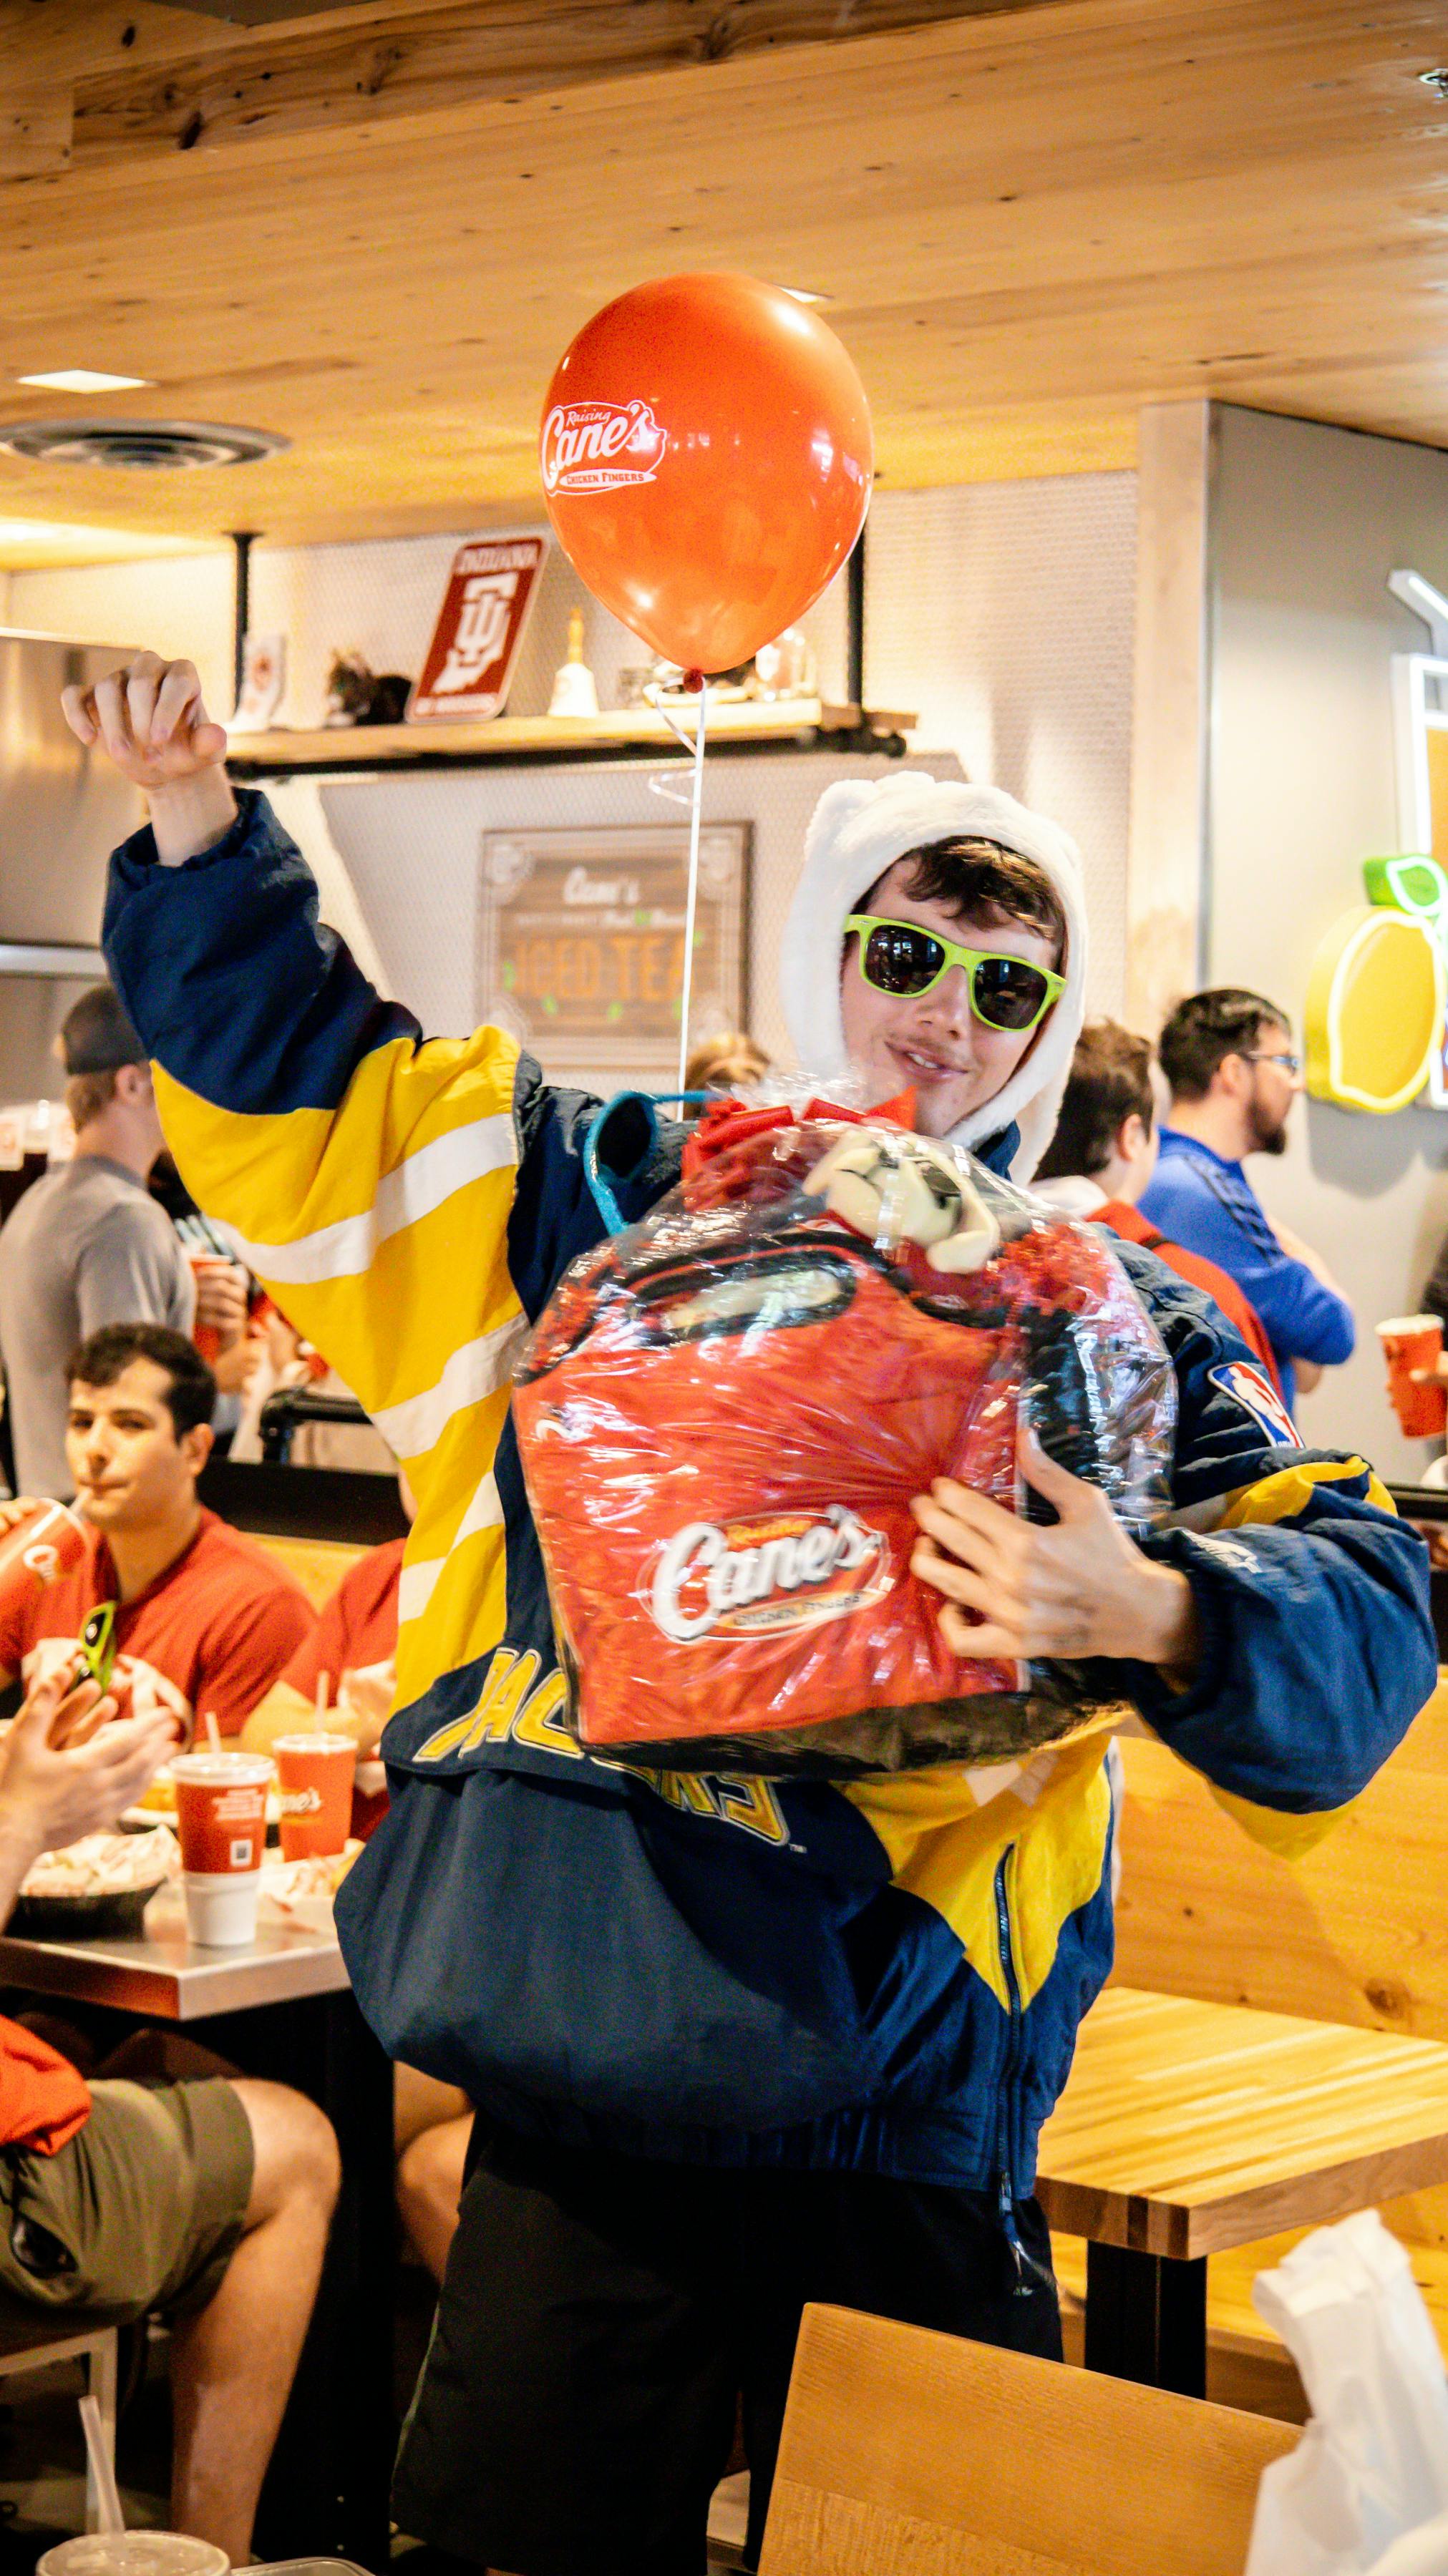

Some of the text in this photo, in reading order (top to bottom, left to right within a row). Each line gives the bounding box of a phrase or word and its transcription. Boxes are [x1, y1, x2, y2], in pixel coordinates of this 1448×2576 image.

[542, 404, 660, 489] Cane's
[567, 409, 612, 426] Raising
[566, 472, 644, 485] CHICKEN FINGERS
[514, 936, 603, 1000] ICED
[653, 1504, 882, 1641] Cane's
[412, 1646, 790, 1848] PACS
